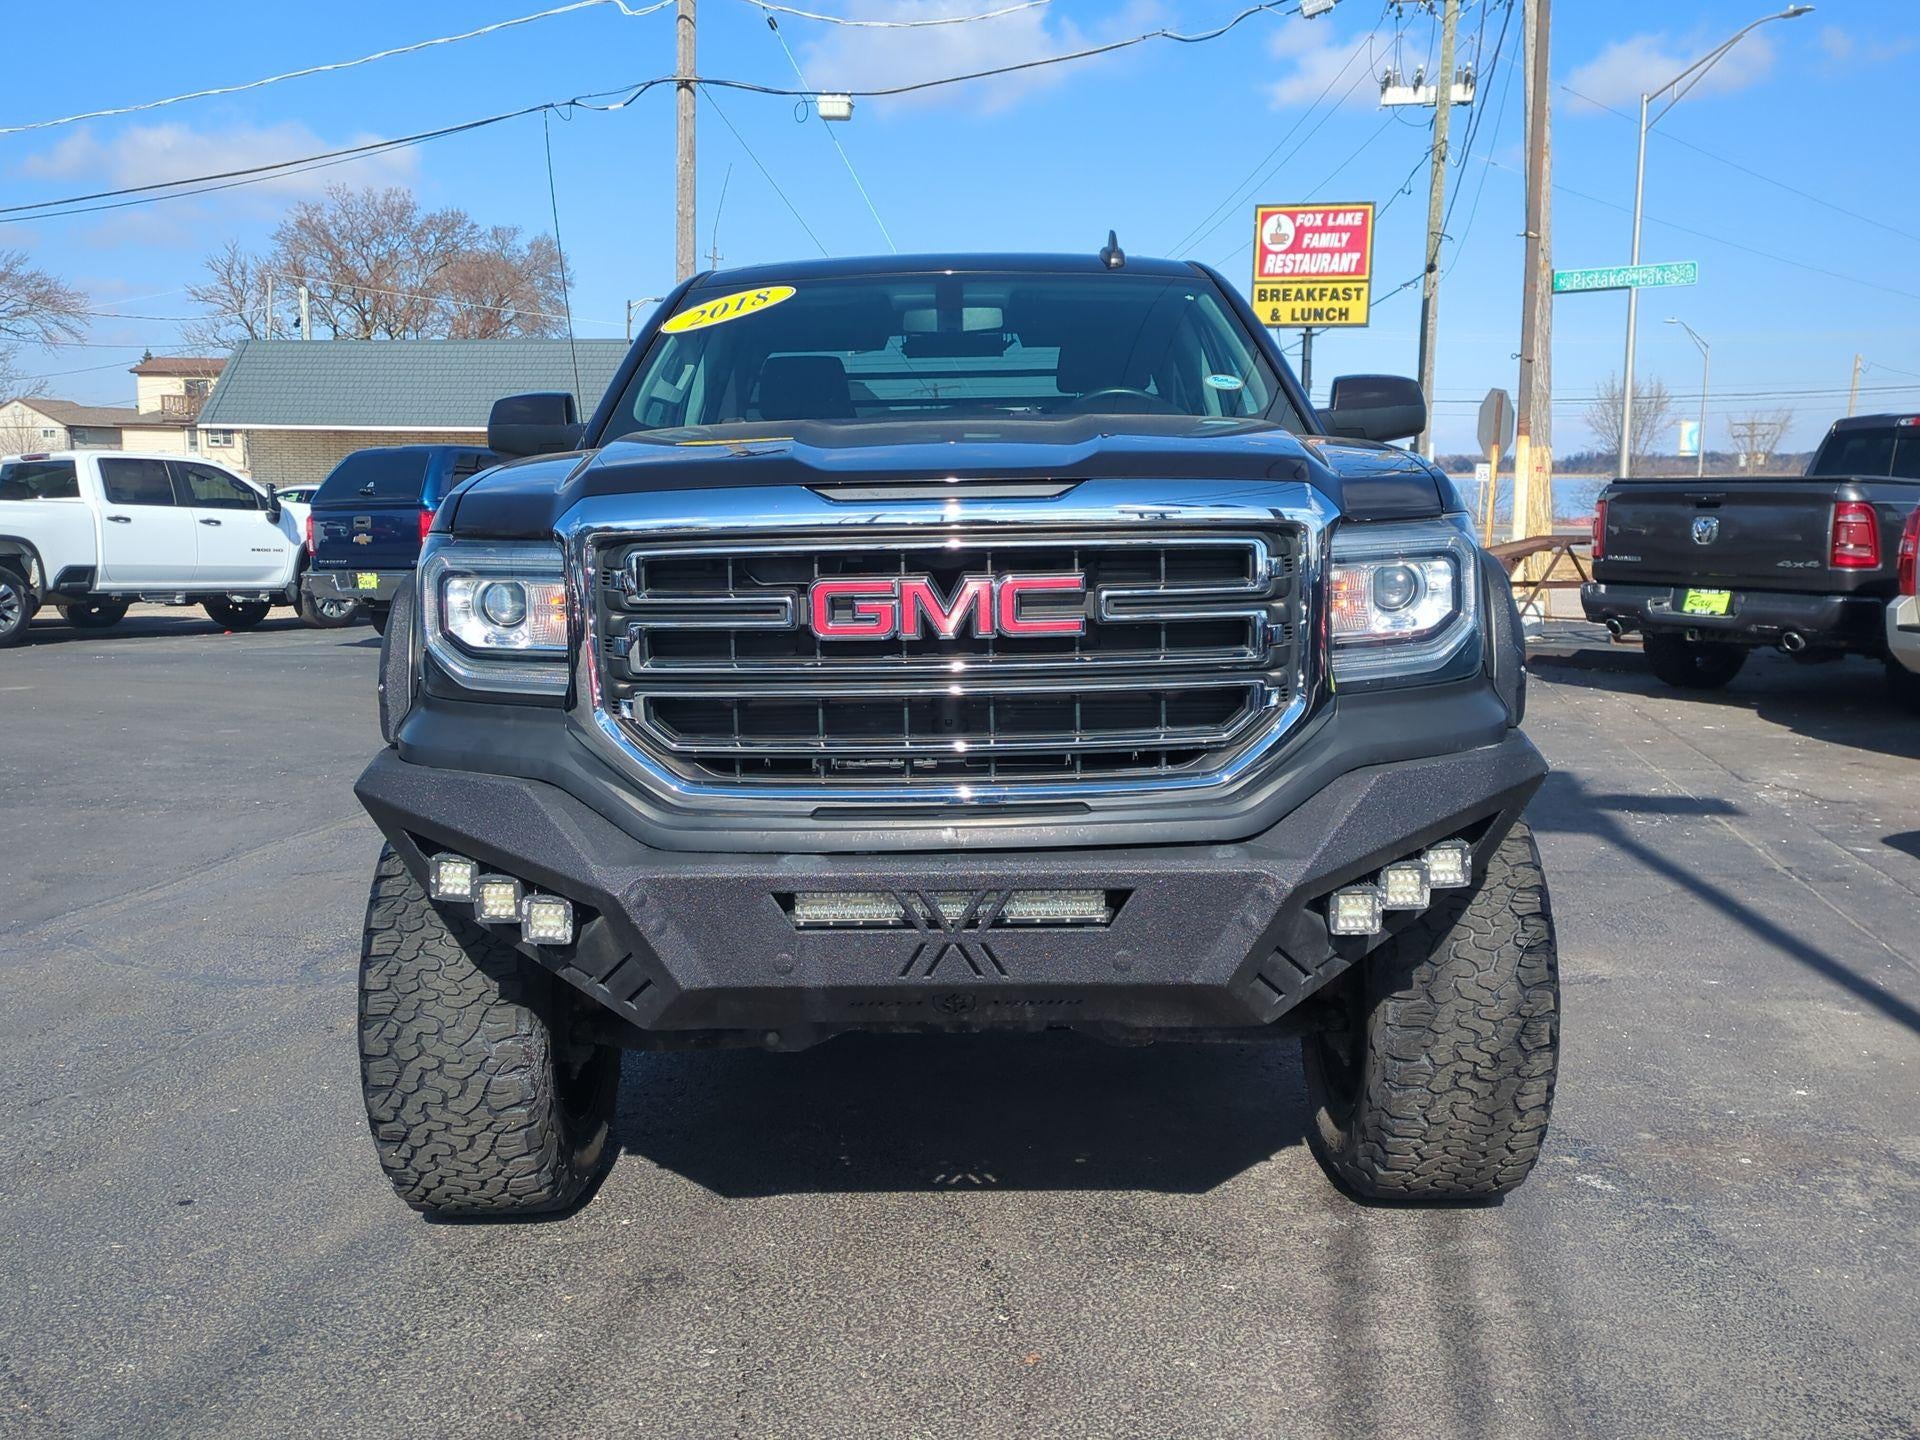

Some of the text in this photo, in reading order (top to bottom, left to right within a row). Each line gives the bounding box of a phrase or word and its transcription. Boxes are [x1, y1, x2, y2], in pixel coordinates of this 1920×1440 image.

[1296, 212, 1363, 227] FOX LAKE
[1302, 232, 1350, 248] FAMILY
[1264, 252, 1361, 274] RESTAURANT
[1573, 271, 1633, 288] Pistakee
[1639, 268, 1672, 286] Lake
[1258, 287, 1364, 302] BREAKFAST
[687, 290, 771, 328] 2018
[1270, 307, 1350, 322] & LUNCH
[808, 572, 1087, 641] GMC
